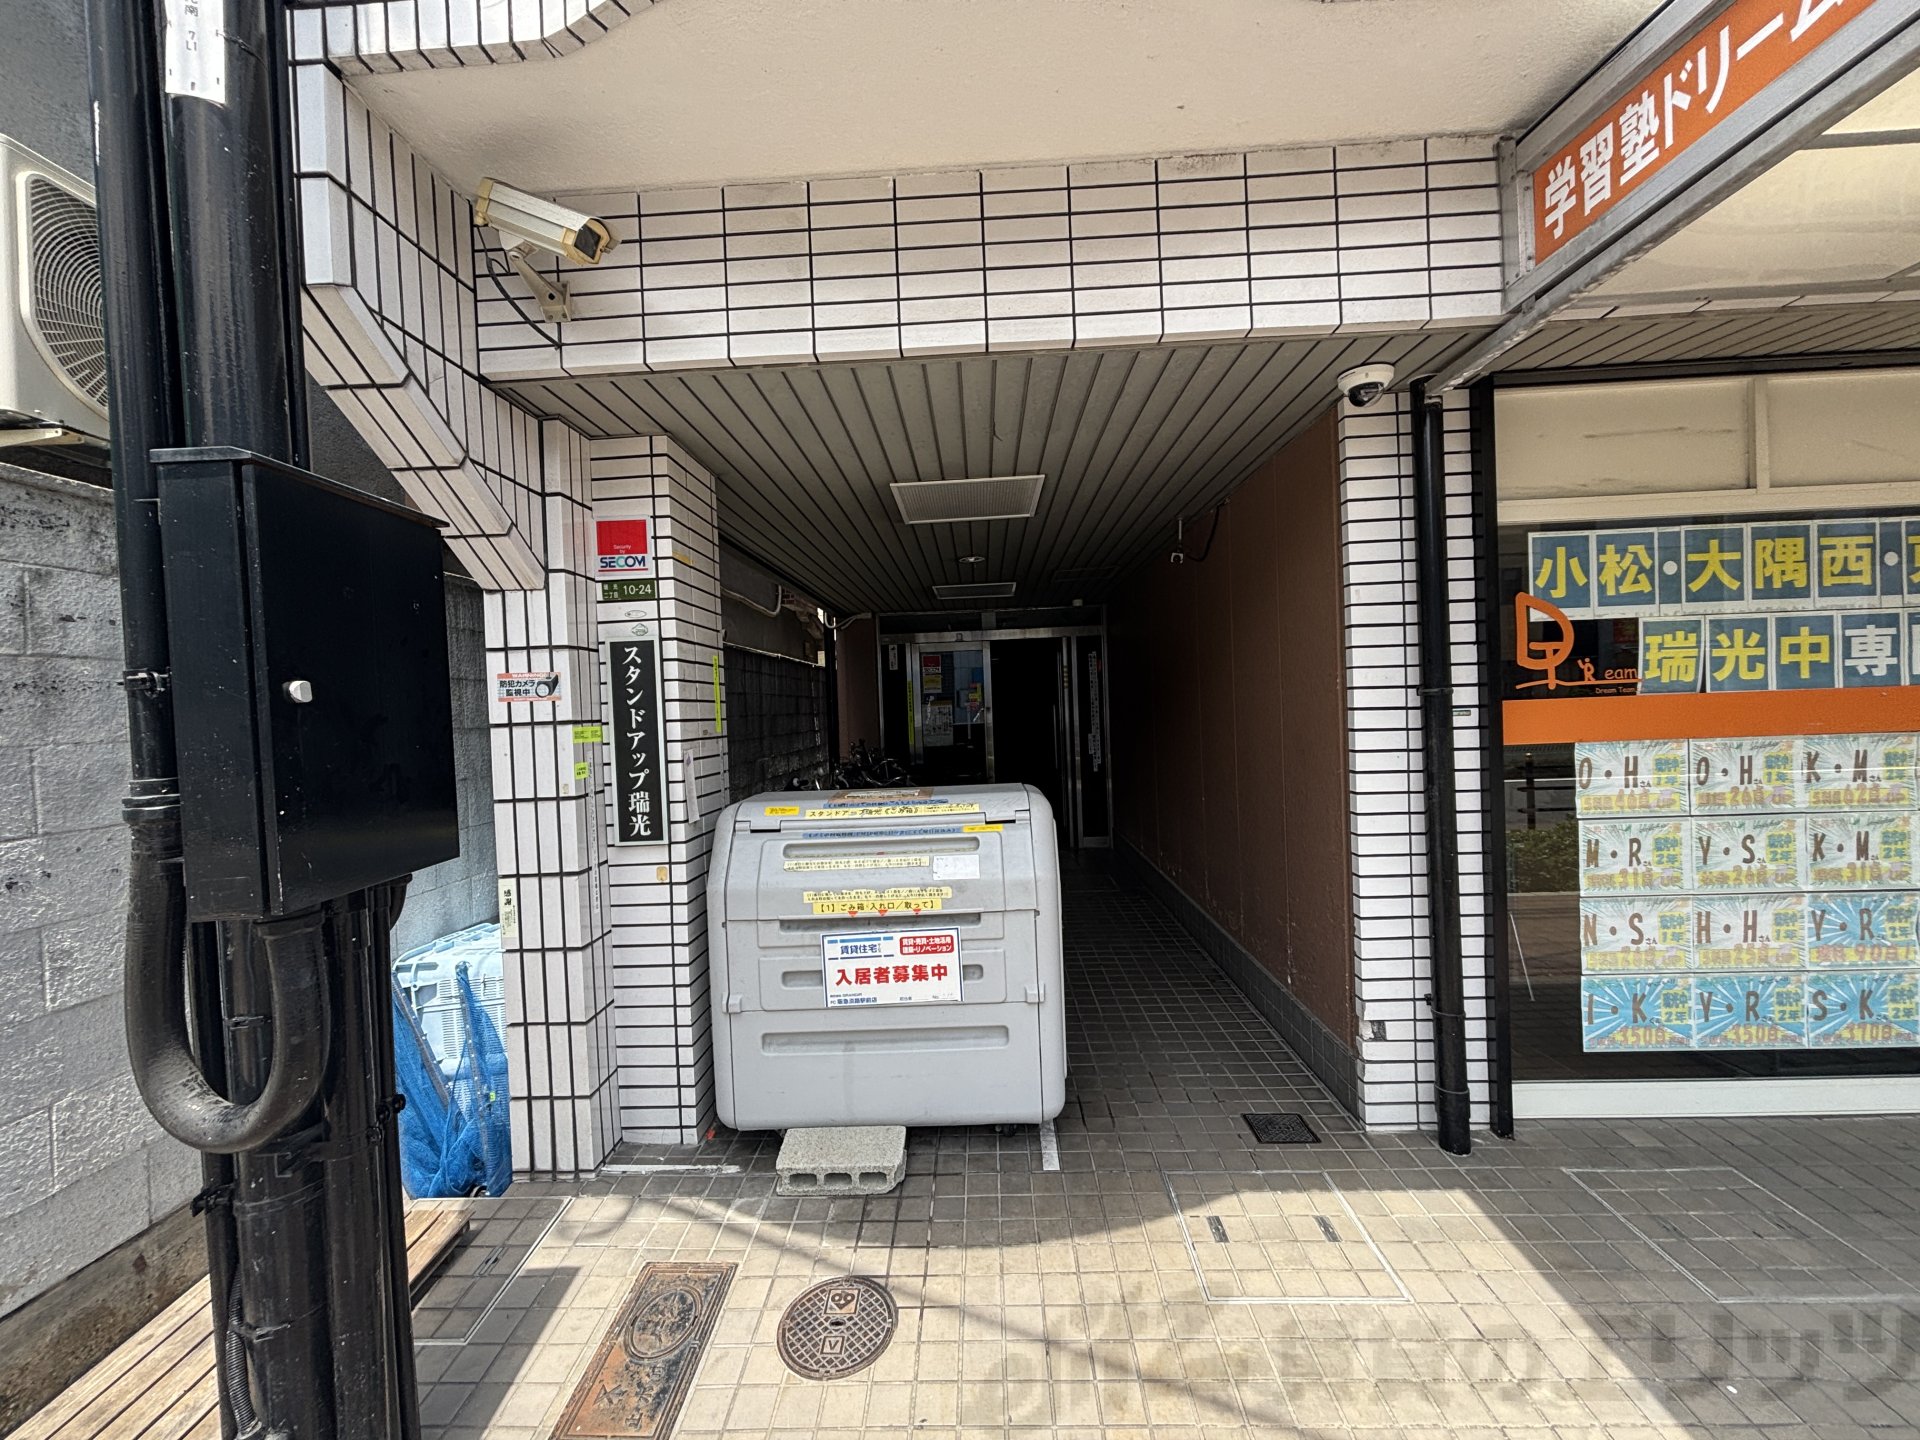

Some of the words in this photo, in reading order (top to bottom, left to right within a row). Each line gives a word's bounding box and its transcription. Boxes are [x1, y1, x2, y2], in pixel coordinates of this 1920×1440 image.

[600, 555, 646, 568] SECOM
[1535, 535, 1920, 599] 小松・大隅西・
[623, 584, 652, 595] 10-24
[499, 680, 536, 688] 防犯カメラ
[505, 688, 531, 696] 監視中
[622, 645, 652, 837] スタンドアップ瑞光
[840, 944, 878, 955] 賃貸住宅
[835, 964, 948, 986] 入居者募集中
[828, 1339, 839, 1350] V
